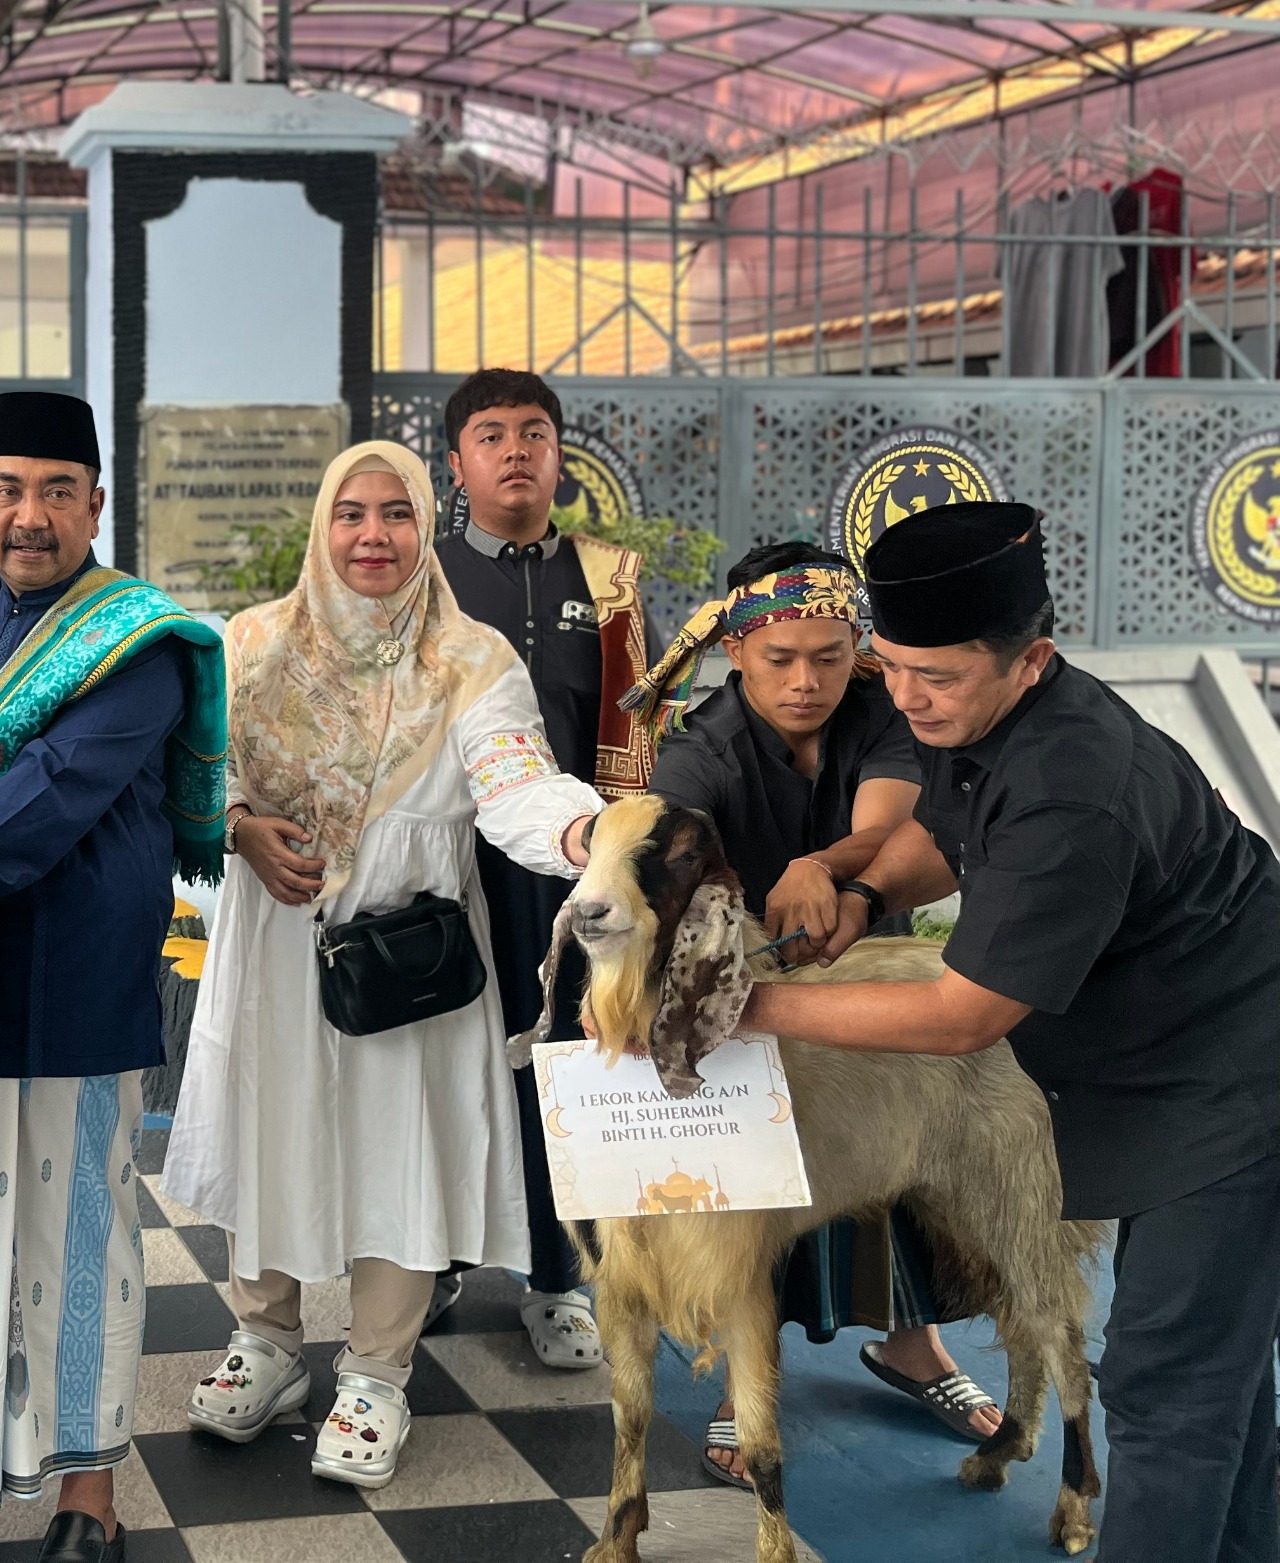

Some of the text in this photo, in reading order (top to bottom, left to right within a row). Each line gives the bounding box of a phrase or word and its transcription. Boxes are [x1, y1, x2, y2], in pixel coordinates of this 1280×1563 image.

[561, 428, 587, 446] AN
[829, 458, 863, 557] MENTERIAN
[925, 430, 957, 447] DAN
[589, 1091, 635, 1107] EKOR
[637, 1087, 715, 1102] KAMNG
[719, 1083, 750, 1099] A/N
[611, 1104, 725, 1125] HJ. SUHERMIN
[601, 1121, 742, 1143] BINTI H. GHOFUR
